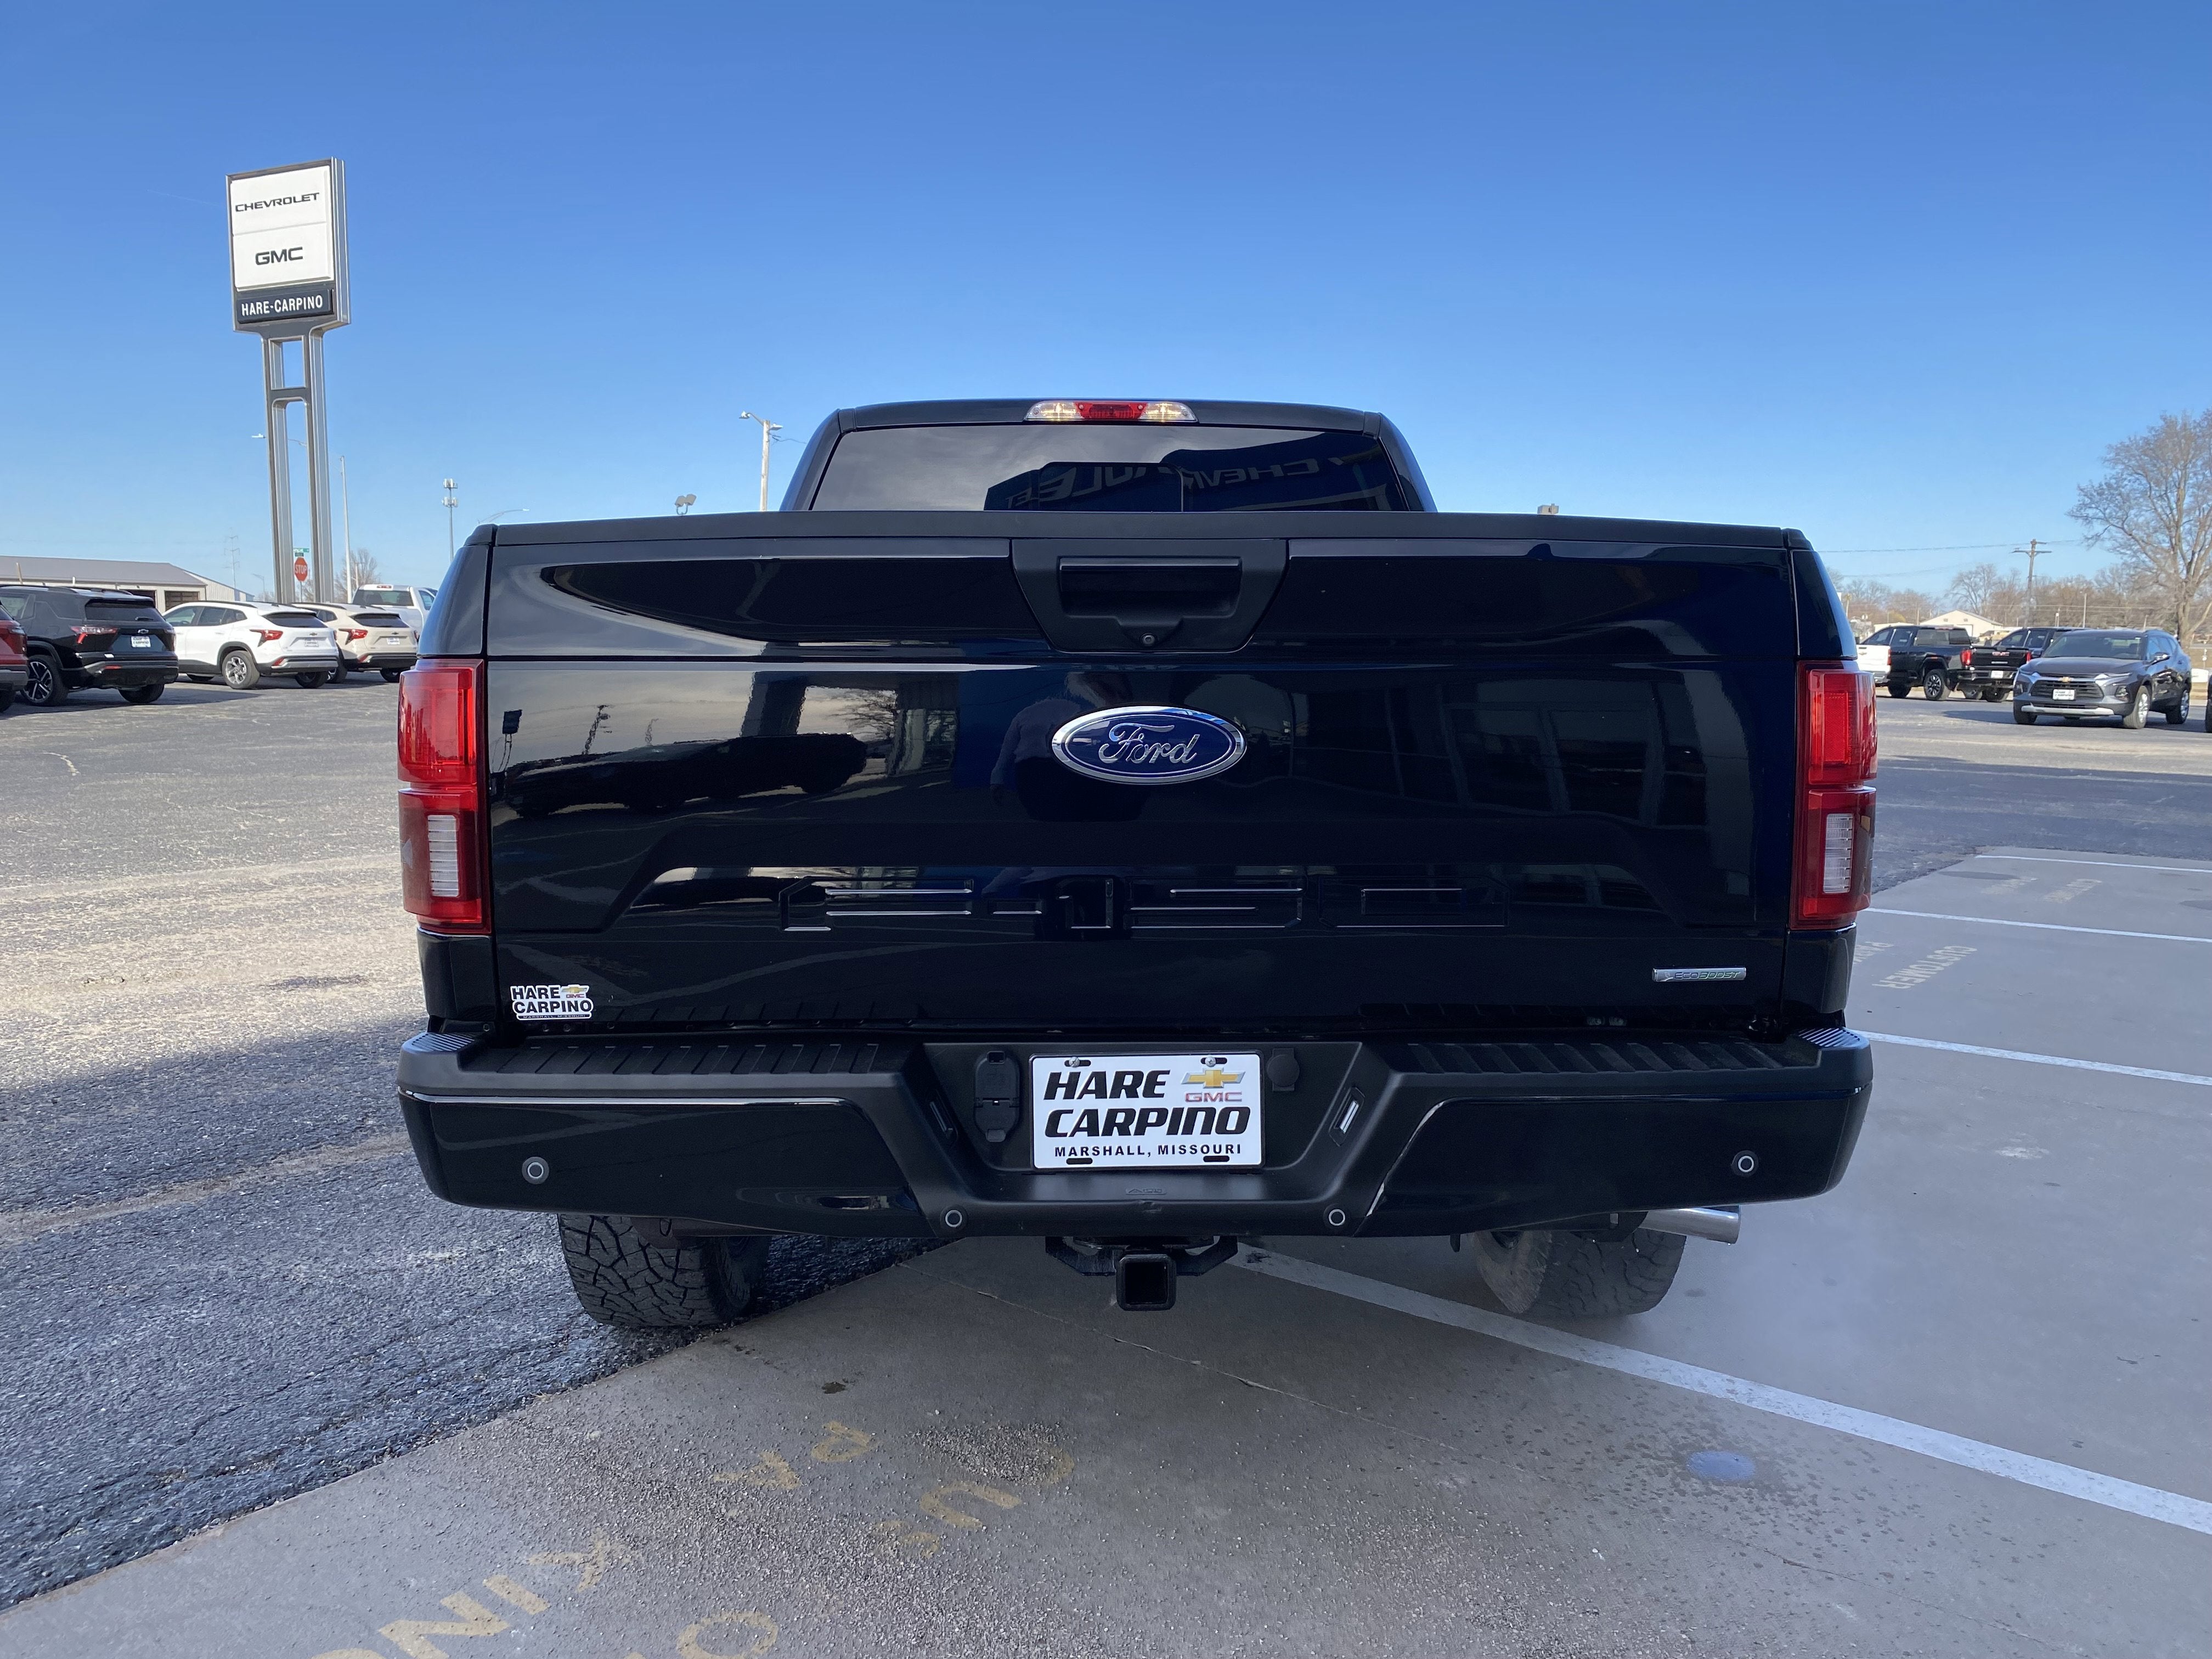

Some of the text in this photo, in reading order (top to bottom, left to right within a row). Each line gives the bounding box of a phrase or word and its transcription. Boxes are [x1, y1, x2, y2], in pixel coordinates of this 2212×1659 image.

[235, 192, 320, 212] CHEVROLET
[255, 246, 303, 266] GMC
[241, 295, 323, 317] HARE-CARPINO
[295, 565, 307, 574] STOP
[1098, 722, 1200, 764] Ford
[779, 876, 1513, 932] F-150
[1871, 945, 1978, 990] CUSTOMER
[512, 987, 561, 1000] HARE
[514, 1000, 592, 1014] CARPINO
[1043, 1069, 1170, 1101] HARE
[1184, 1091, 1243, 1103] GMC
[1045, 1106, 1251, 1138] CARPINO
[1054, 1144, 1242, 1158] MARSHALL, MISSOURI
